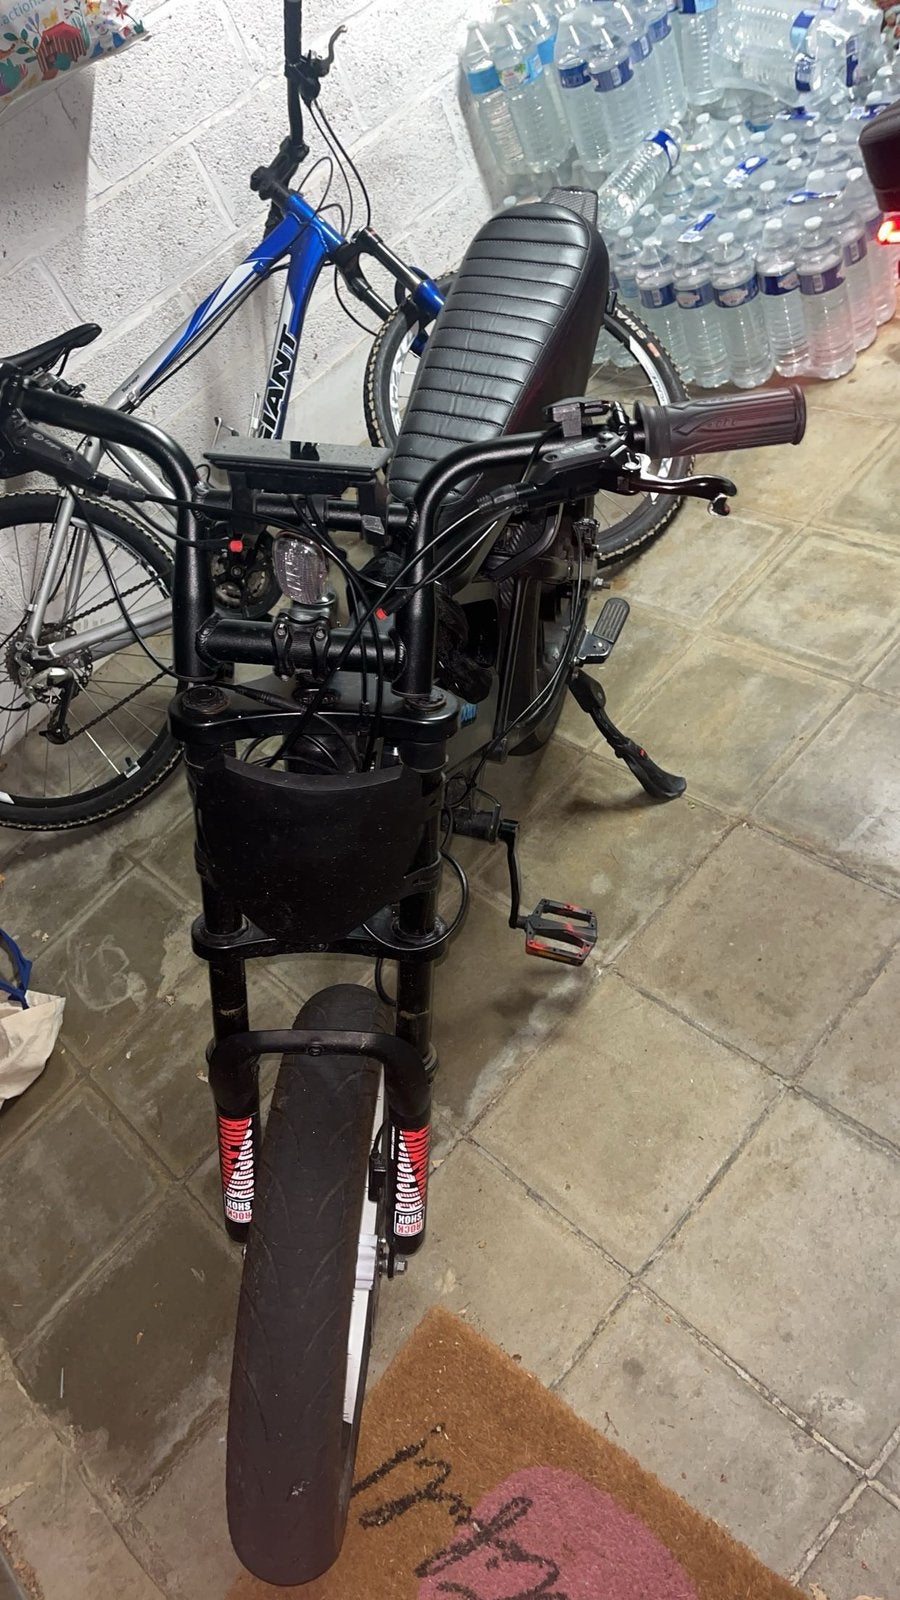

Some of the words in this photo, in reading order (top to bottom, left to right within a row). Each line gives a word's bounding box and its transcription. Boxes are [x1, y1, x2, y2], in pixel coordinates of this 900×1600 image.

[226, 1198, 251, 1211] SHOX
[398, 1211, 422, 1225] SHOX
[397, 1221, 422, 1234] ROCK
